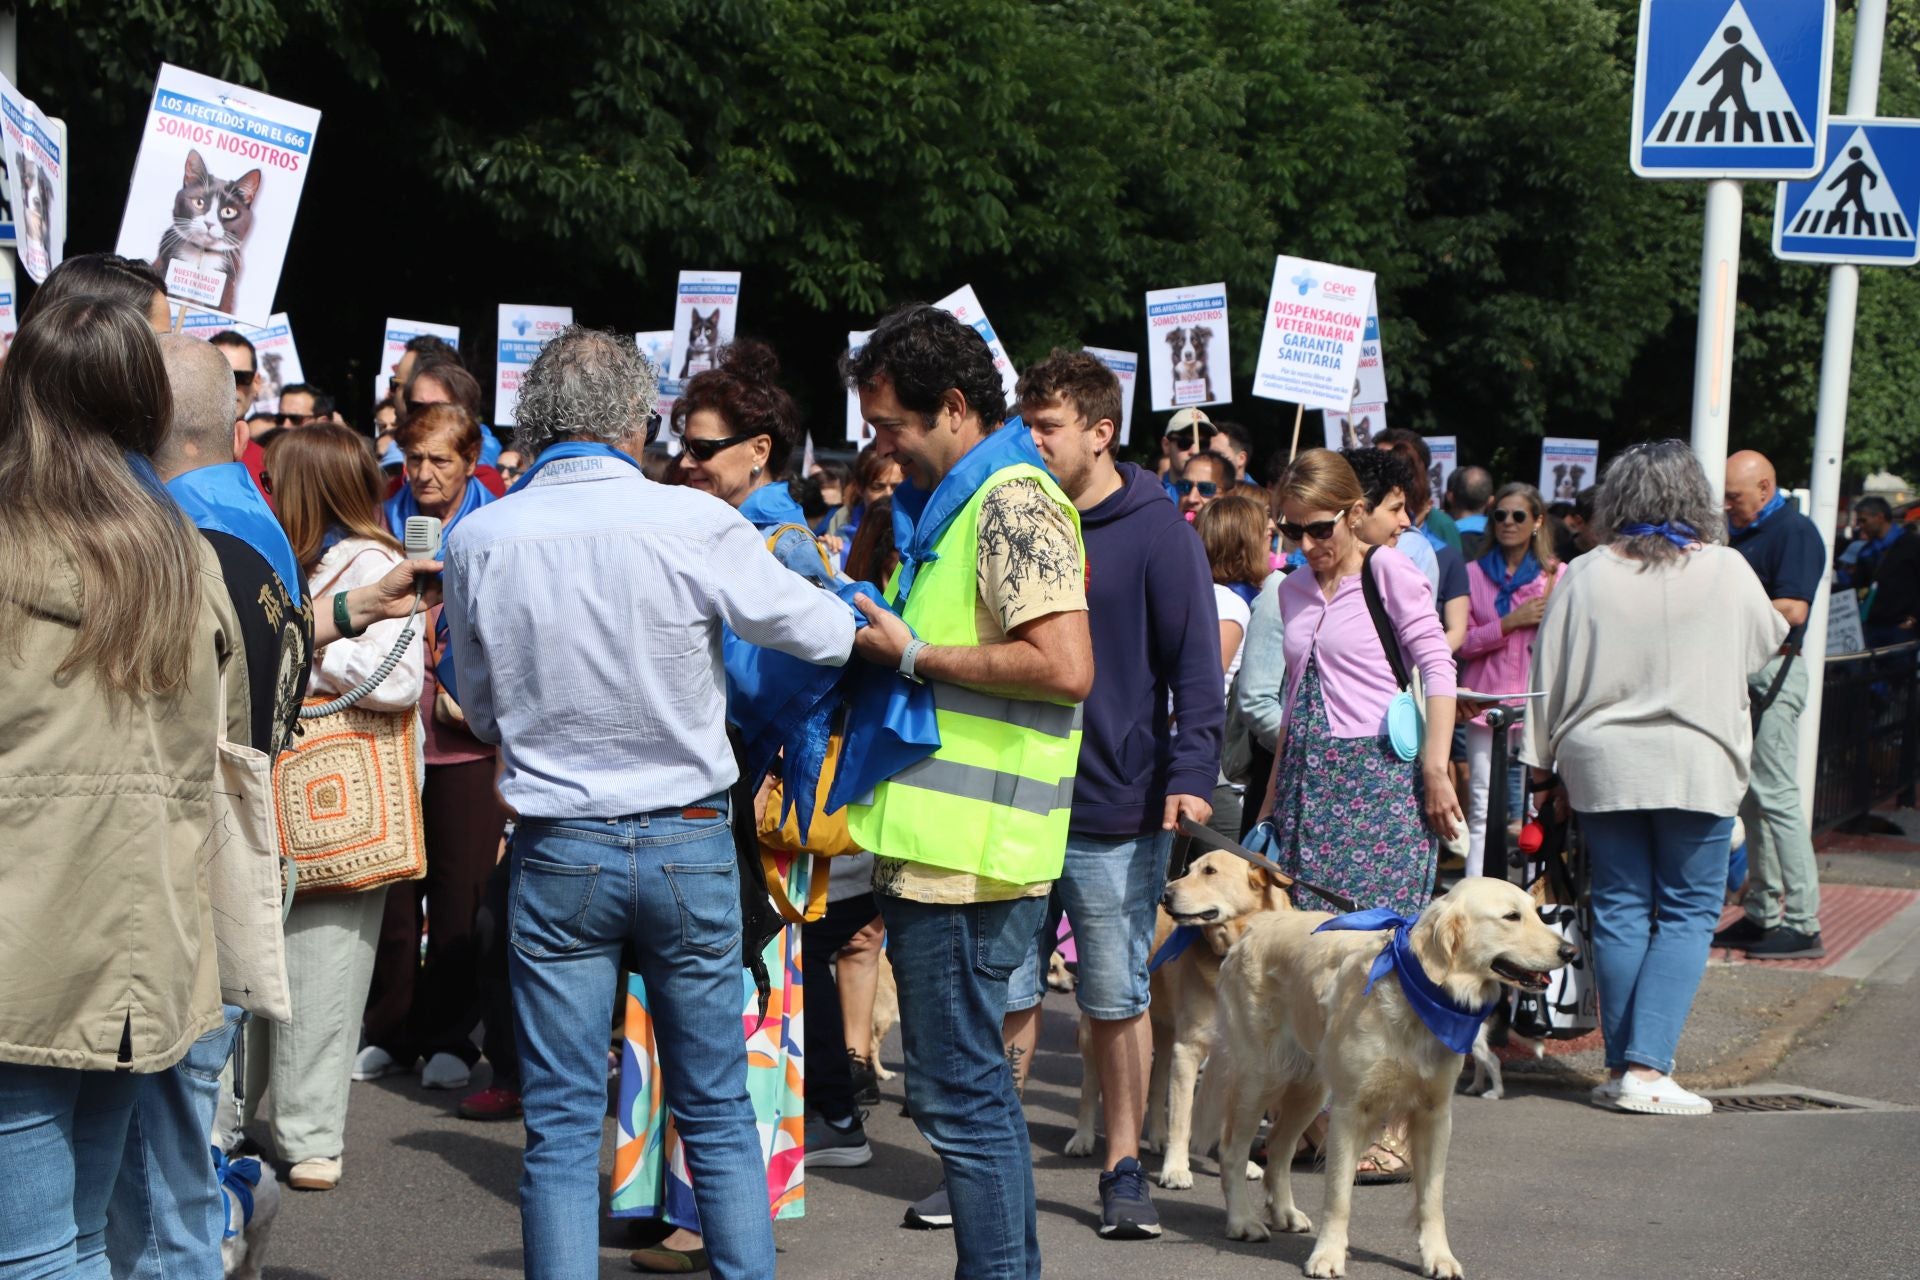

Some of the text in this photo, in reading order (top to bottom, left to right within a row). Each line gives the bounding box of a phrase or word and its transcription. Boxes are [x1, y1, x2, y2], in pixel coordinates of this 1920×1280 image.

[161, 95, 182, 112] LOS
[183, 102, 245, 130] AFECTADOS
[246, 120, 270, 138] POR
[270, 128, 283, 142] EL
[284, 132, 305, 148] 666
[156, 116, 300, 171] SOMOS NOSOTROS
[1323, 280, 1356, 297] ceve
[1152, 310, 1223, 327] SOMOS NOSOTROS
[1273, 300, 1361, 329] DISPENSACIÓN
[1276, 316, 1354, 342] VETERINARIA
[1278, 346, 1341, 369] SANITARIA
